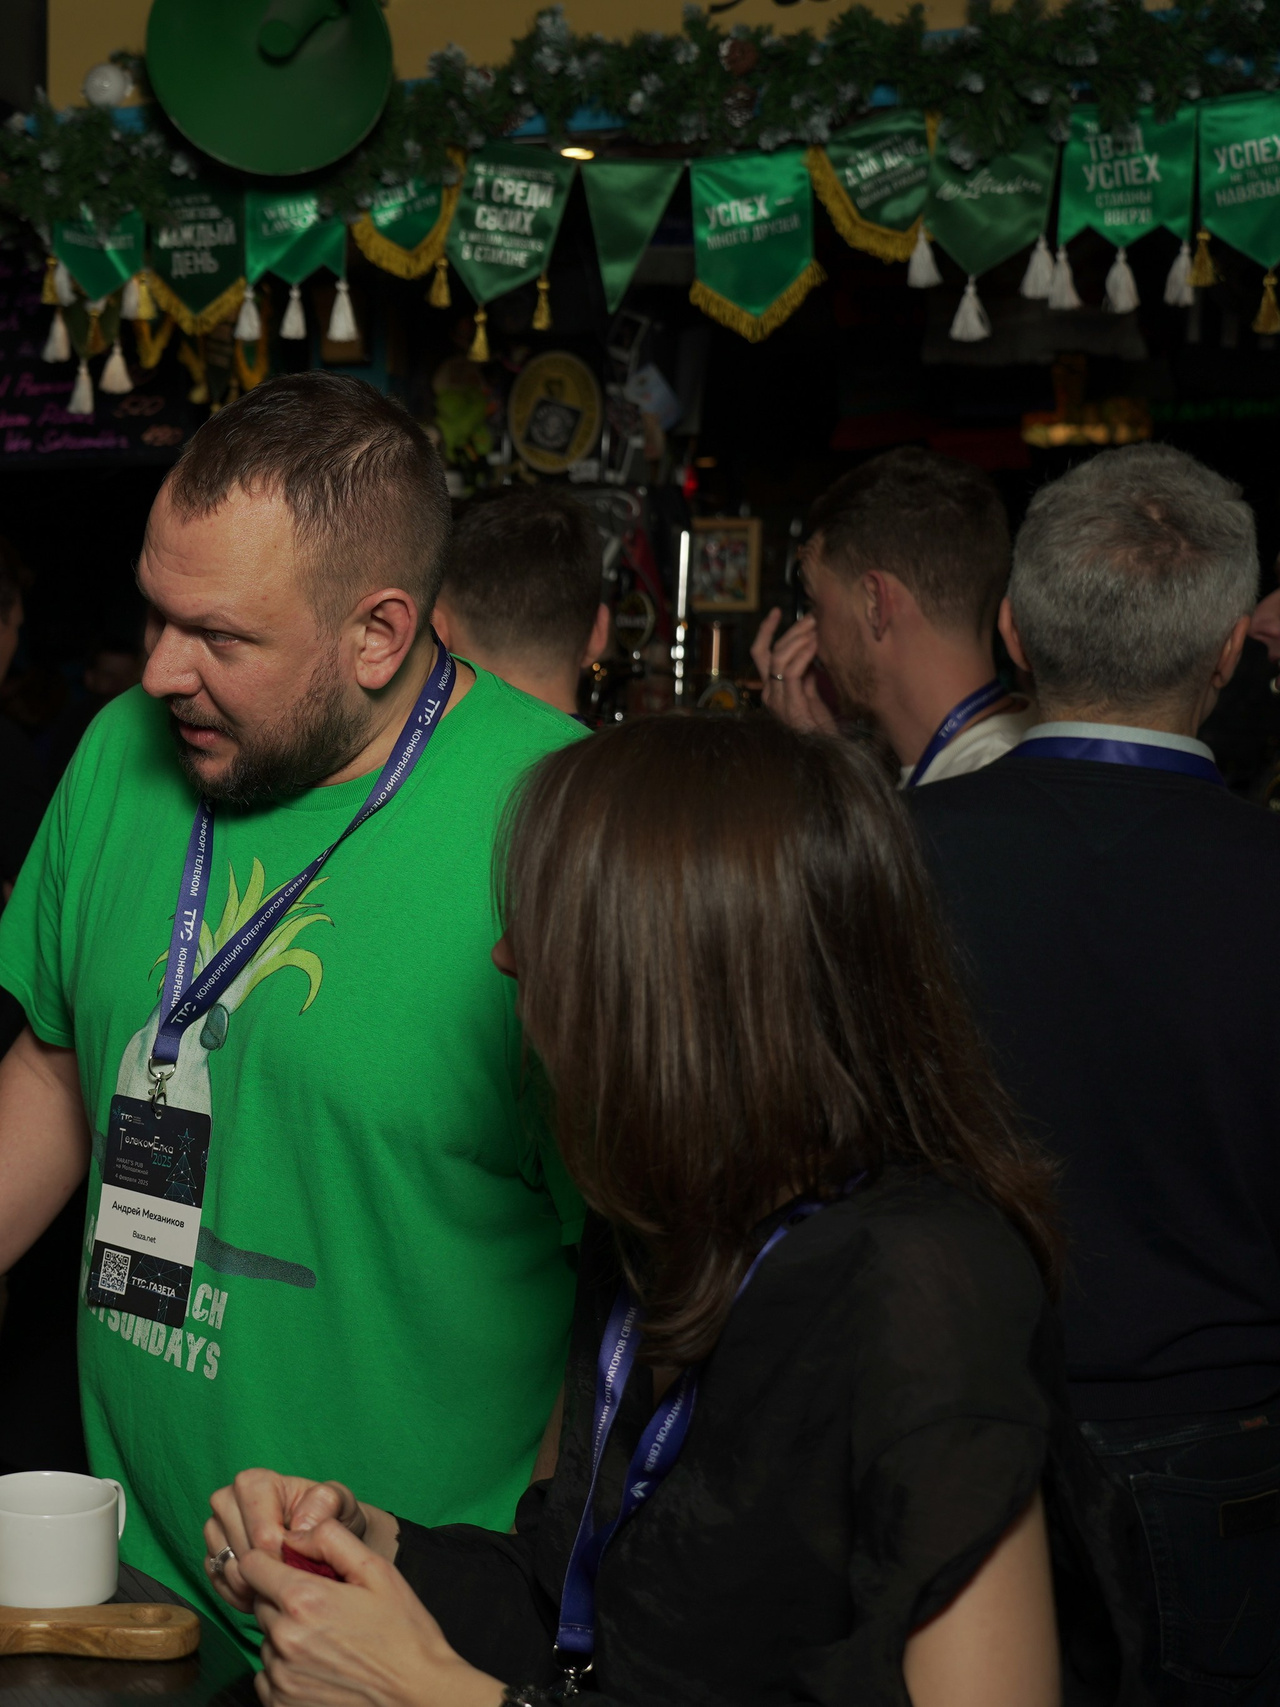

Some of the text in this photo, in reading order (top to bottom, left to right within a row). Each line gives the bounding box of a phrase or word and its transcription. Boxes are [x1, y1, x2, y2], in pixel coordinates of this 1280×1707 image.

[1082, 152, 1162, 193] УСПЕХ
[490, 178, 555, 210] СРЕДИ
[474, 204, 537, 235] СВОИХ
[704, 193, 770, 230] УСПЕХ
[384, 728, 423, 792] КОНФЕРЕНЦИЯ
[189, 816, 209, 897] ЭФФОРТ ТЕЛЕКОМ
[195, 944, 243, 1001] КОНФЕРЕНЦИЯ
[241, 897, 285, 946] ОПЕРАТОРОВ
[284, 873, 308, 897] СВЯЗИ
[152, 1152, 173, 1168] 2025
[112, 1200, 185, 1228] Андрей Механиков
[132, 1230, 157, 1244] Baza.net
[131, 1276, 176, 1297] ТТС.ГАЗЕТА
[605, 1339, 627, 1403] ОПЕРАТОРОВ
[620, 1306, 638, 1338] СВЯЗИ
